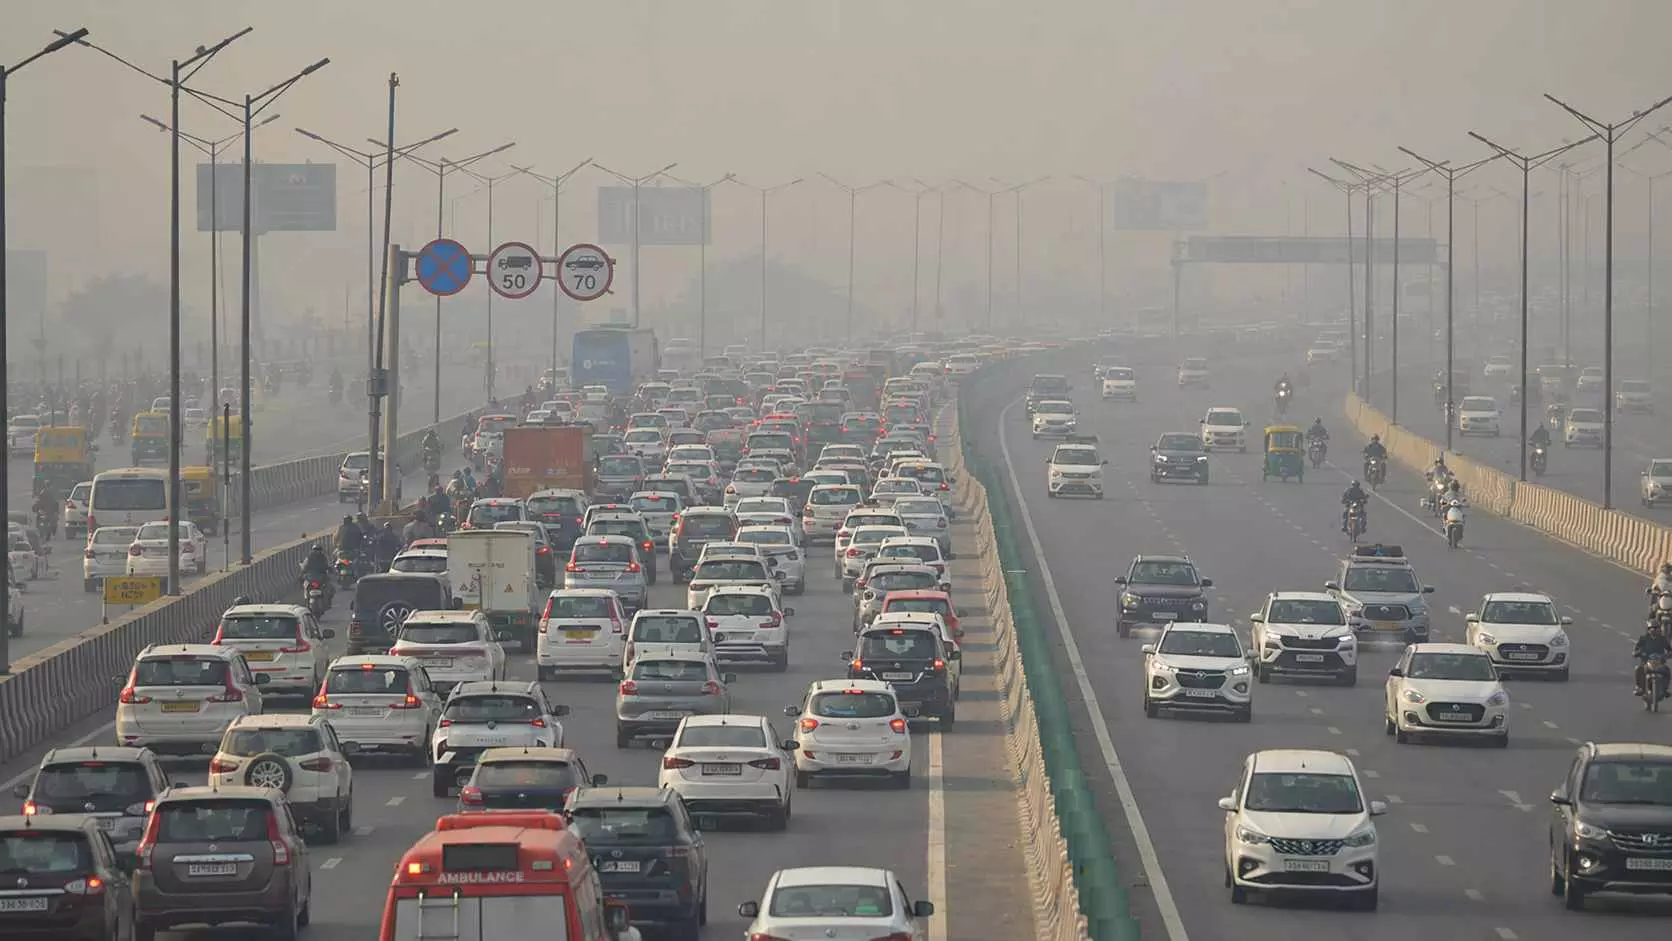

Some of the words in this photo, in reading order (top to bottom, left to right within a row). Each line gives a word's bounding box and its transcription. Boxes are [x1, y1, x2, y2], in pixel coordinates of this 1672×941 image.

[502, 274, 526, 289] 50
[573, 275, 596, 290] 70
[437, 871, 525, 884] AMBULANCE
